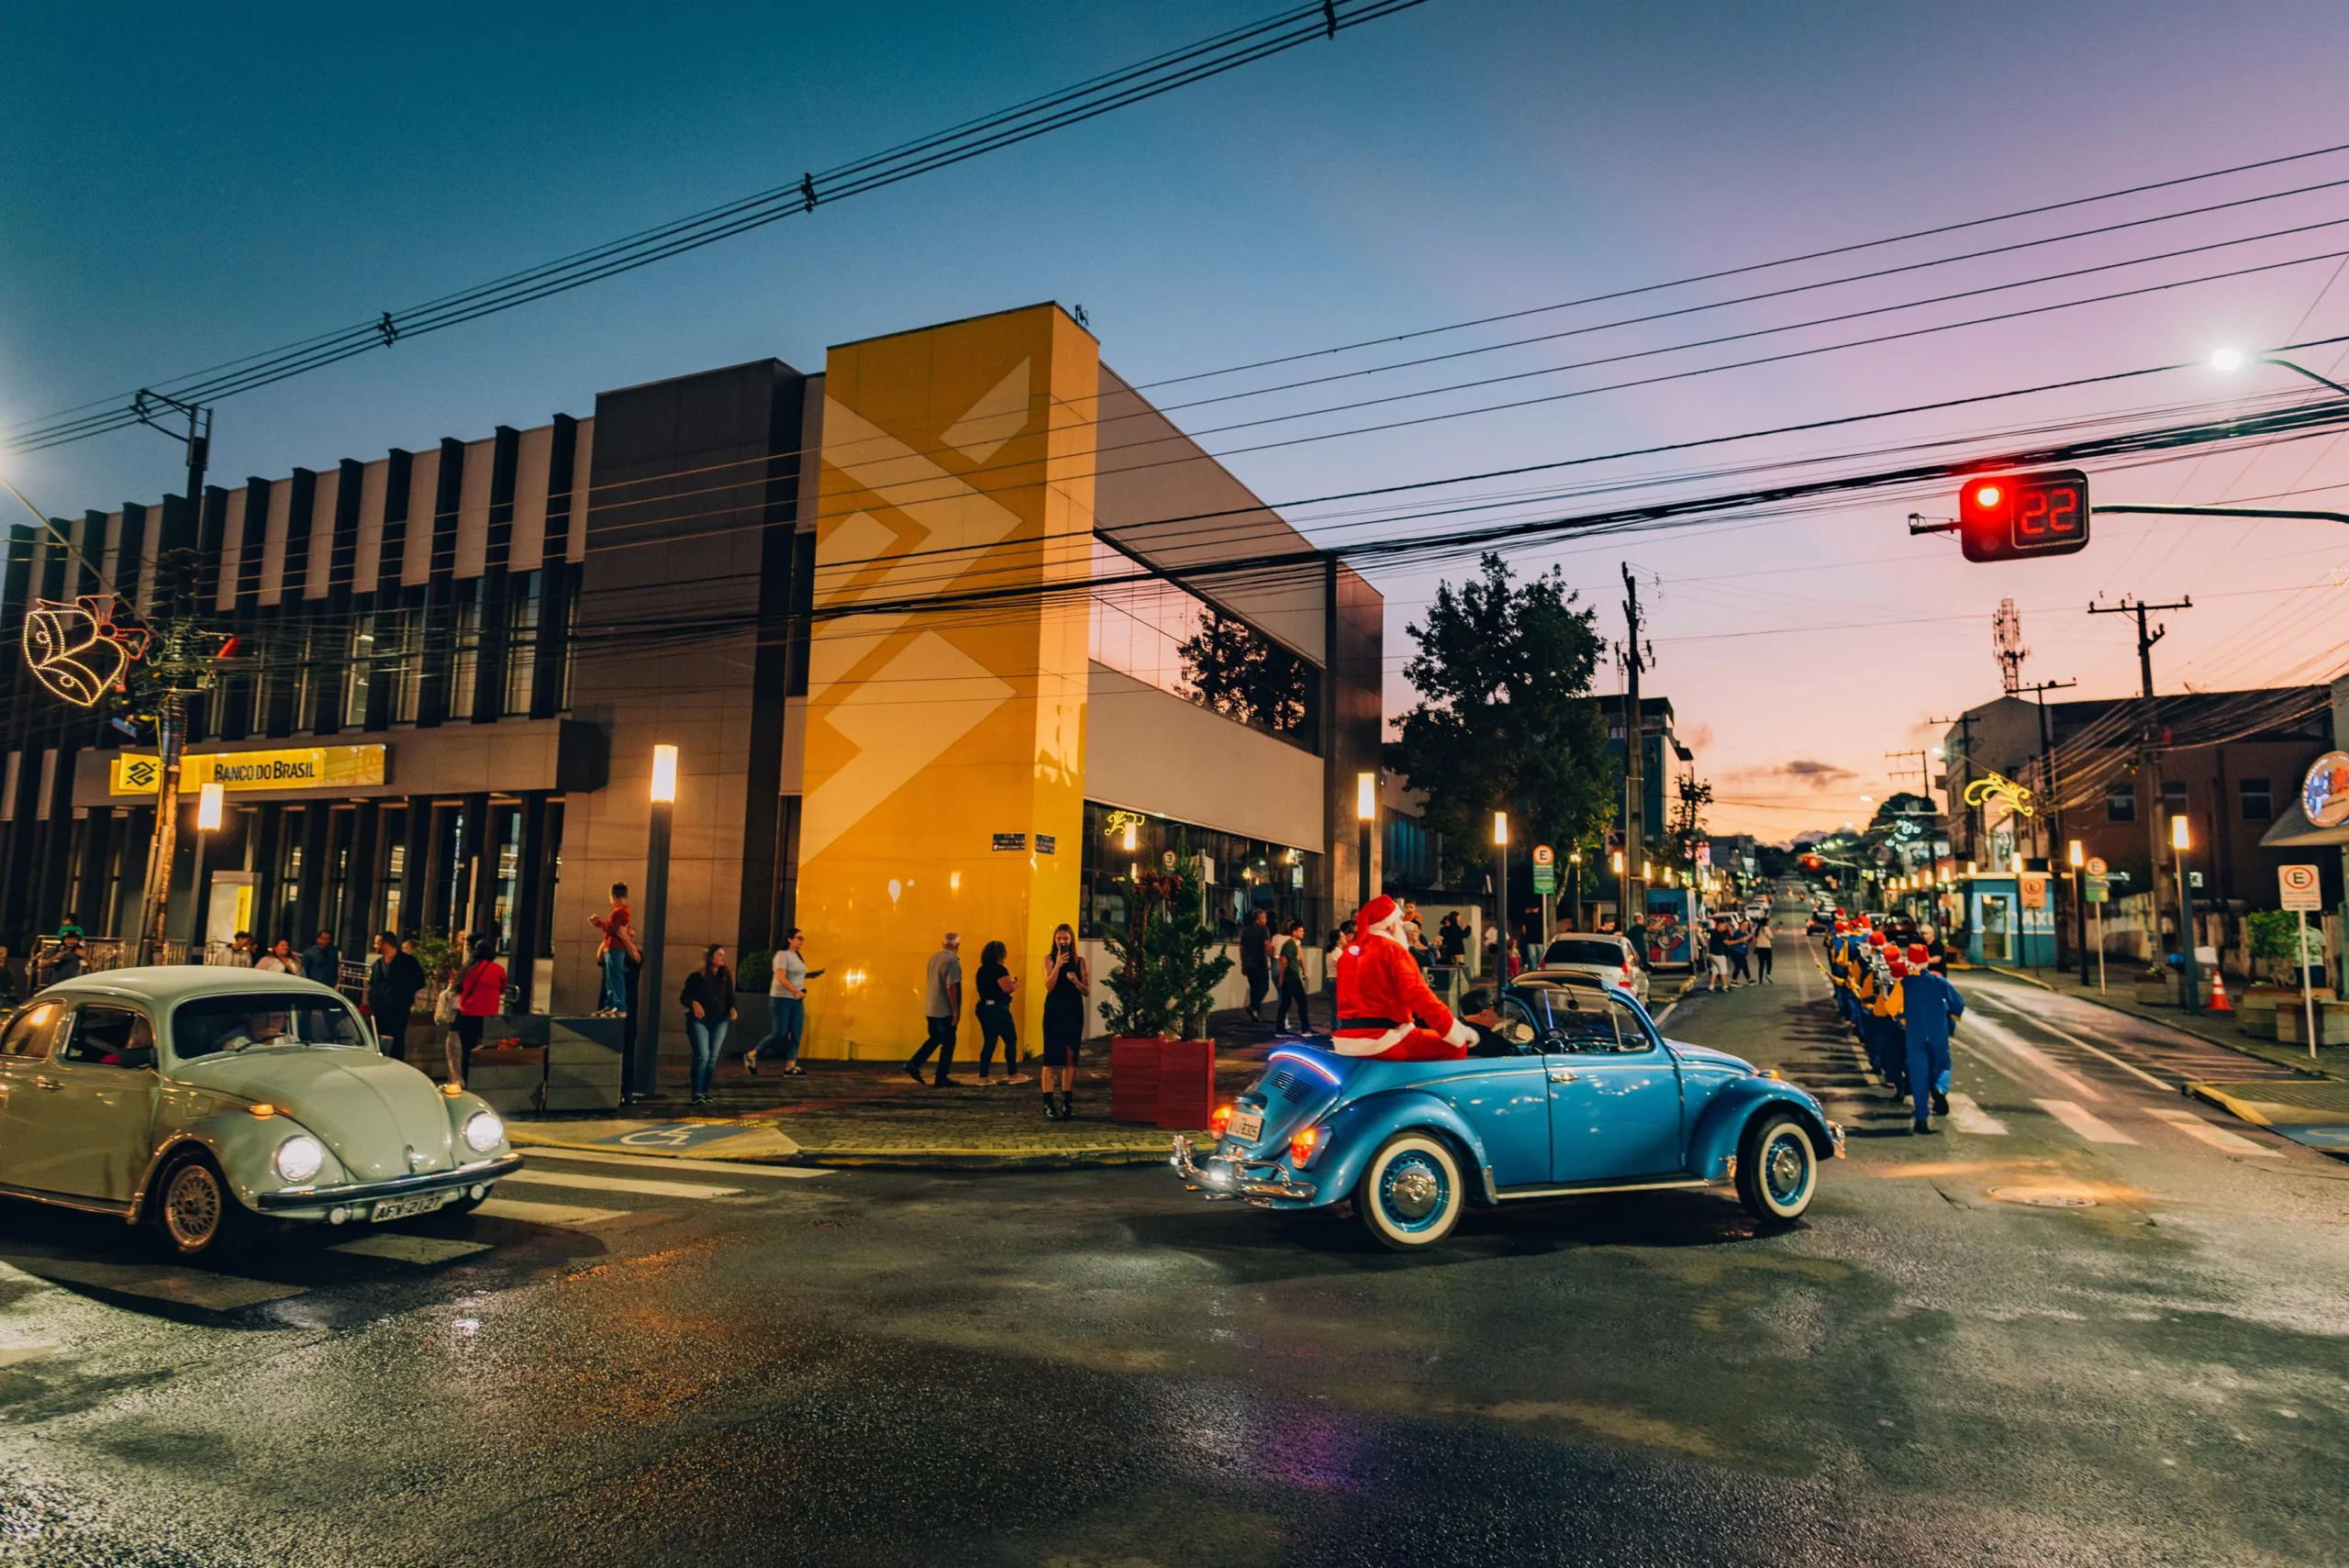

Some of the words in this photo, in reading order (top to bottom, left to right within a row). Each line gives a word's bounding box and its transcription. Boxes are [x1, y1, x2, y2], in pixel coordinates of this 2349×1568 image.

[2021, 488, 2076, 536] 22
[214, 762, 254, 781] BANCO
[256, 763, 273, 780] DO
[273, 760, 316, 779] BRASIL
[1540, 850, 1548, 861] E
[2091, 861, 2102, 873] E
[2293, 872, 2305, 884] E
